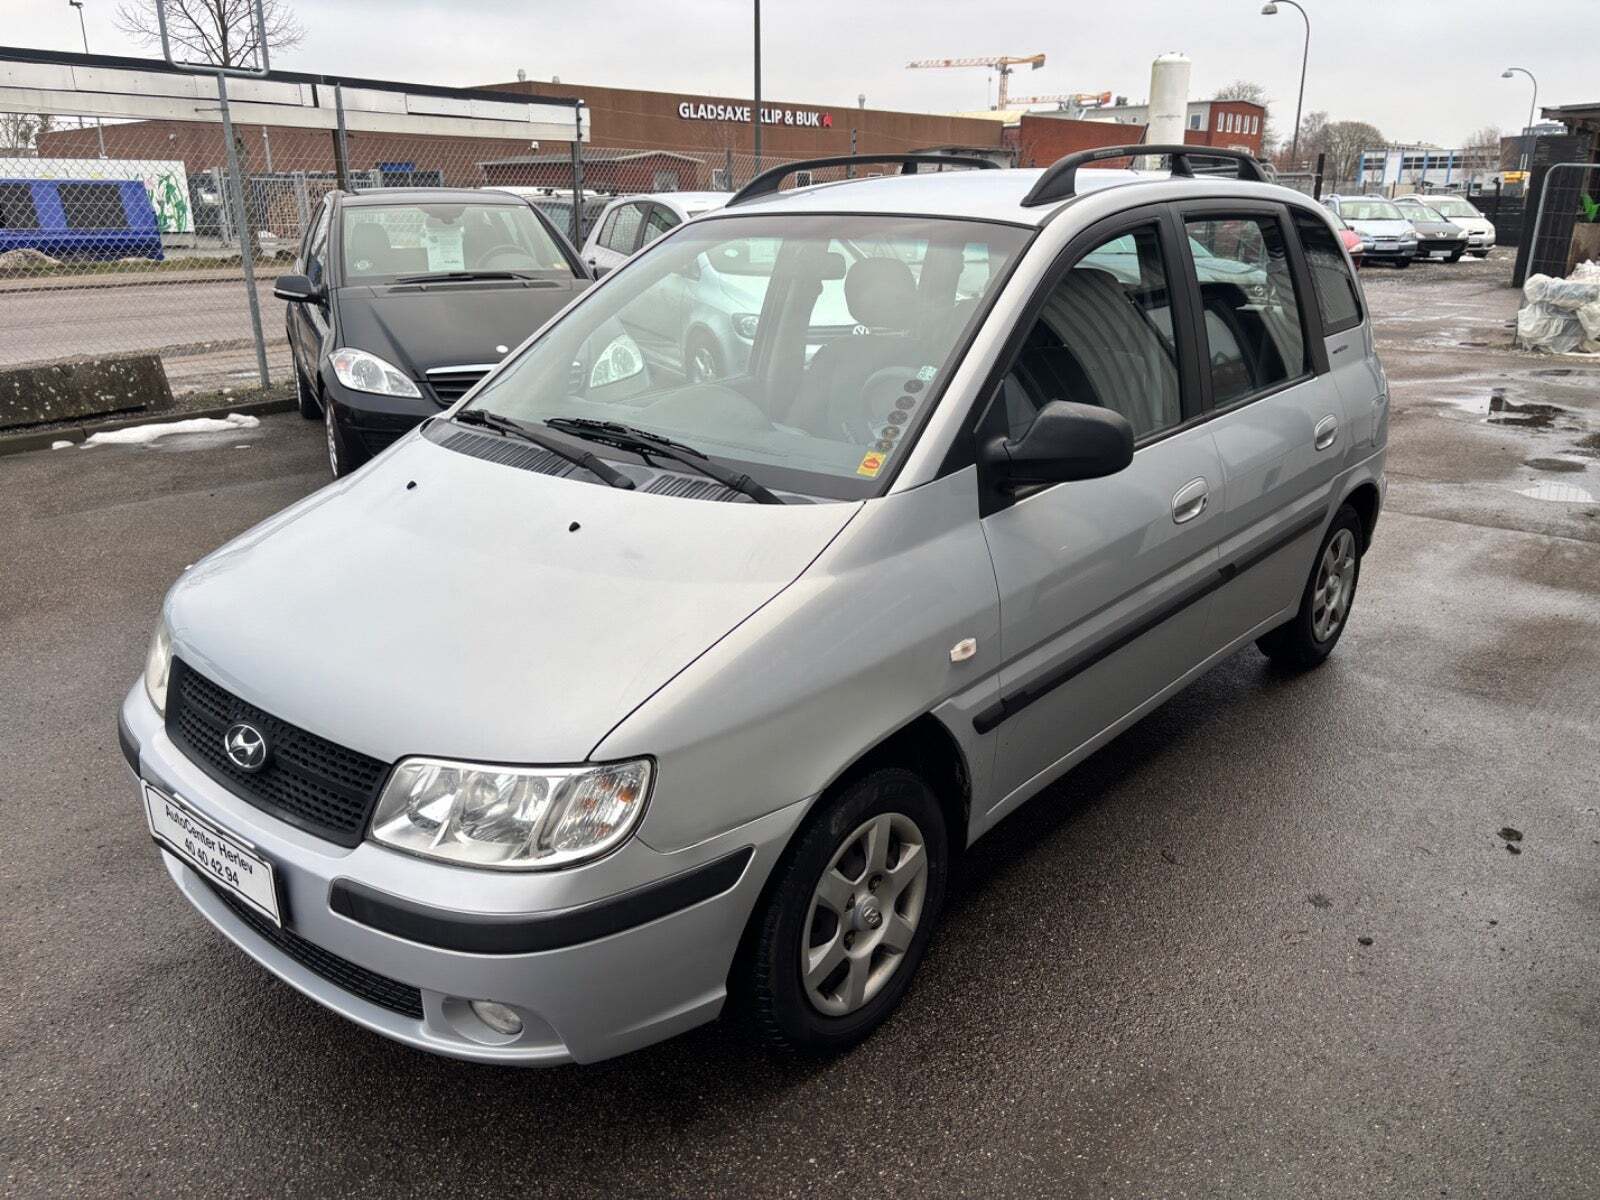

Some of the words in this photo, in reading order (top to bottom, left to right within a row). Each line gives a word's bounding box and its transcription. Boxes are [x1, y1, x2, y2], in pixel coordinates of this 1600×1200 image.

[679, 102, 751, 122] GLADSAXE
[784, 111, 794, 125] &
[796, 111, 819, 127] BUK
[165, 804, 216, 851] AutoCenter
[218, 841, 253, 875] Herlev
[184, 838, 195, 857] 40
[197, 849, 209, 867] 40
[211, 858, 224, 877] 42
[226, 867, 240, 886] 94
